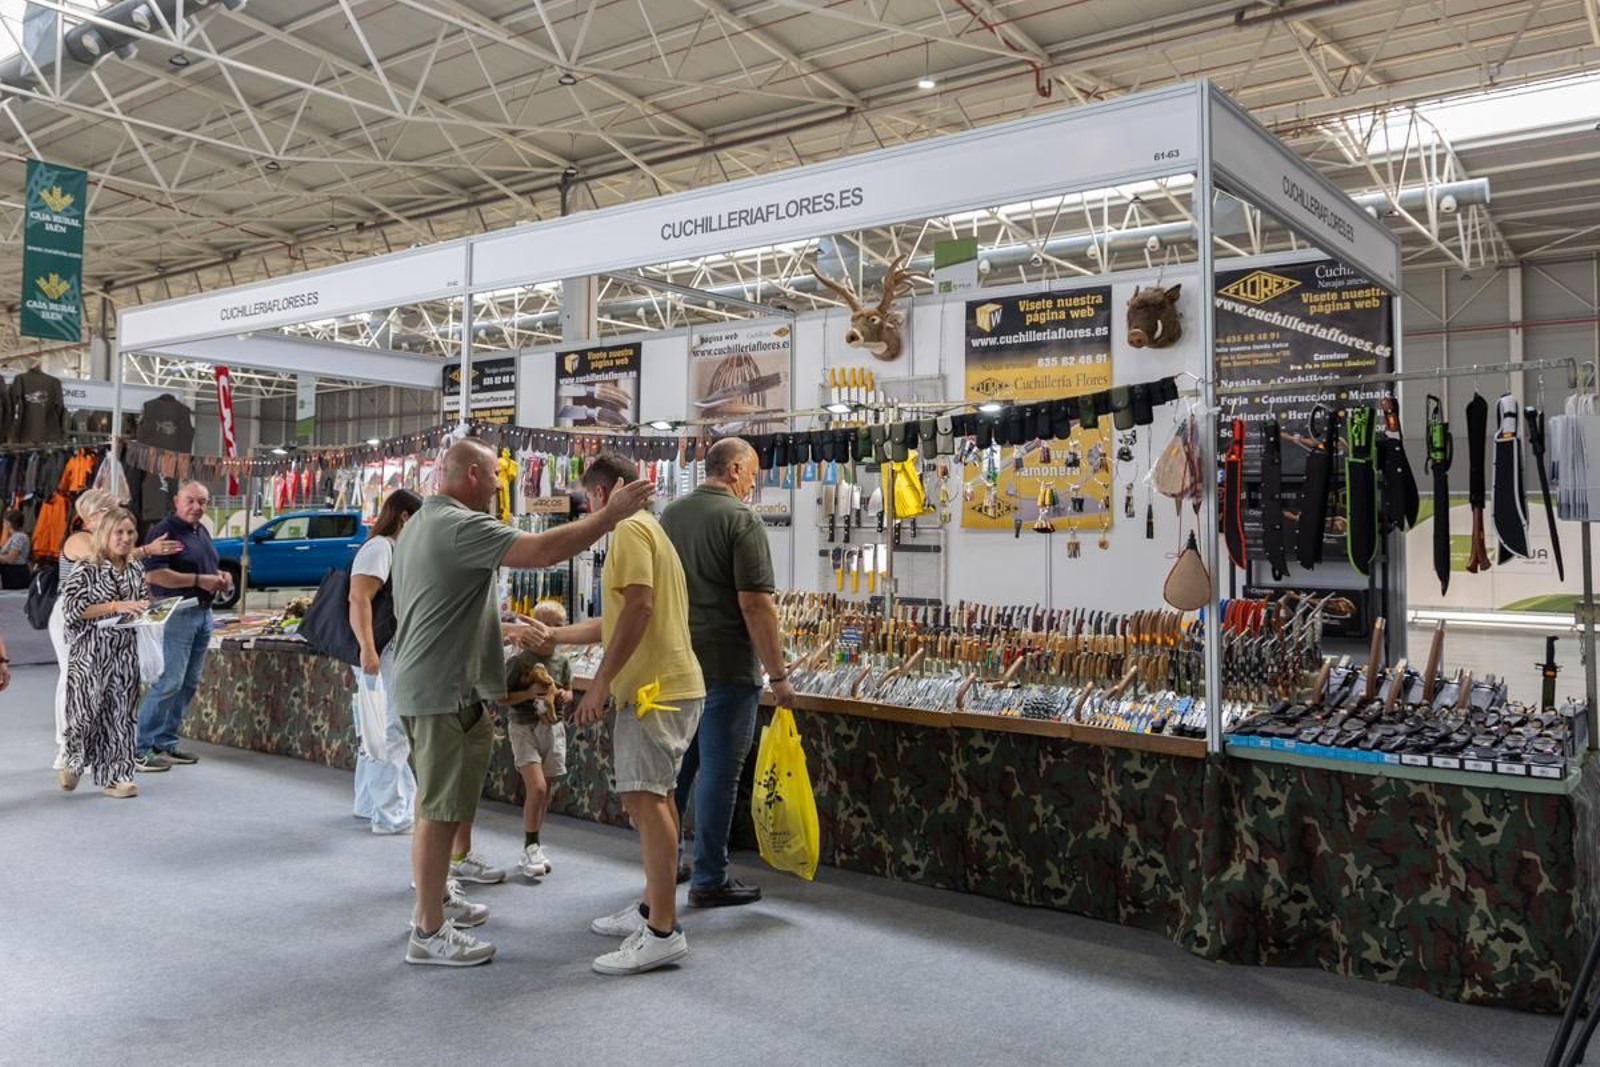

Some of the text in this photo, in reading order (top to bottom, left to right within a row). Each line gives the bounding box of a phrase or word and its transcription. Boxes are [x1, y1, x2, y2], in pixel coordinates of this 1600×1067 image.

[1153, 149, 1180, 161] 61-63
[660, 187, 864, 241] CUCHILLERIAFLORES.ES
[1282, 175, 1355, 243] CUCHILLERIAFLORES.ES
[52, 214, 82, 227] RURAL
[1228, 271, 1291, 301] FLORES
[220, 291, 319, 321] CUCHILLERIAFLORES.ES
[1057, 294, 1103, 307] nuestra
[1309, 297, 1380, 315] página web
[1025, 305, 1095, 325] página web
[971, 326, 1109, 347] www.cuchilleriaflores.es
[1037, 357, 1058, 368] 635
[1014, 375, 1072, 391] Cuchillería
[1076, 372, 1108, 388] Flores
[1221, 396, 1248, 407] Forja
[1261, 392, 1336, 405] Construcción
